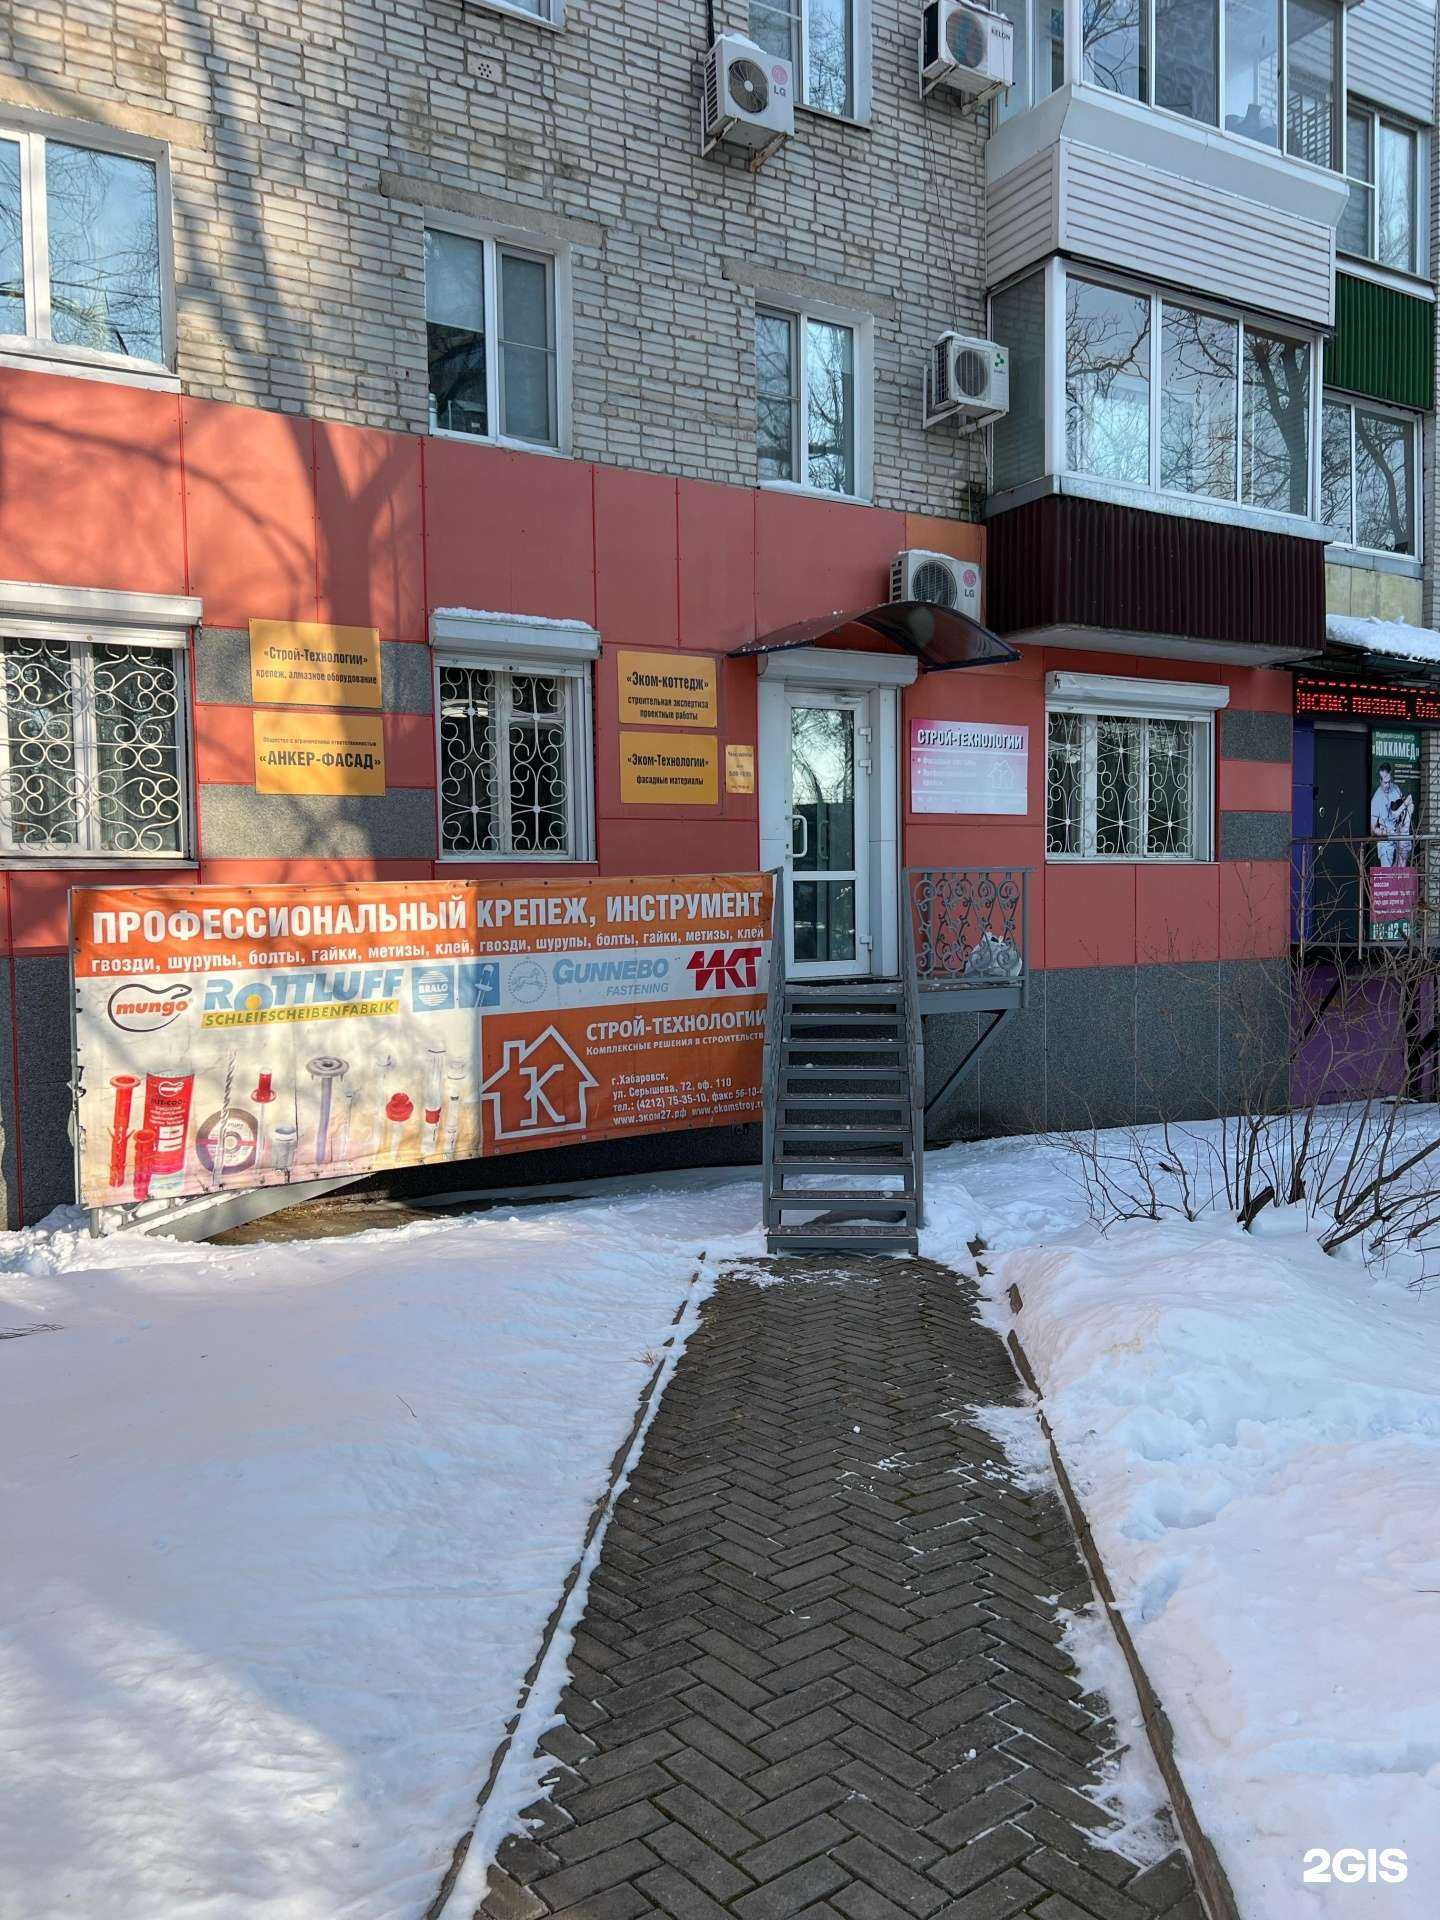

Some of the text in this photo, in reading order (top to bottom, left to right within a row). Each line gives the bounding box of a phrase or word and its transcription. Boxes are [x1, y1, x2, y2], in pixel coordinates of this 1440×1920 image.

[773, 86, 787, 97] LG
[963, 588, 975, 598] LG
[264, 646, 368, 666] «Строй-Технологии»
[327, 673, 377, 685] оборудование
[626, 671, 709, 691] «Эком-коттедж»
[627, 696, 709, 710] строительная экспертиза
[640, 709, 698, 721] проектные работы
[917, 729, 1024, 750] СТРОЙ-ТЕХНОЛОГИИ
[259, 749, 381, 770] «АНКЕР-ФАСАД»
[627, 752, 709, 768] «Эком-Технологии»
[636, 775, 704, 786] фасадные материалы
[92, 892, 763, 944] ПРОФЕССИОНАЛЬНЫЙ КРЕПЕЖ, ИНСТРУМЕНТ
[91, 926, 765, 974] гвозди, шурупы, болты, гайки, метизы, клей, гвозди, шурупы, болты, гайки, метизы, клей
[204, 967, 405, 1012] ROTTLUFF
[418, 982, 449, 994] BRALO
[606, 983, 670, 997] FASTENING
[115, 1000, 190, 1017] mungo
[205, 1001, 396, 1027] SCHLEIFSCHEIBENFABRIK
[586, 1009, 768, 1042] СТРОЙ-ТЕХНОЛОГИИ
[653, 1038, 693, 1049] РЕШЕНИЯ
[702, 1031, 770, 1045] СТРОИТЕЛЬСТВ
[715, 1077, 732, 1088] 110
[636, 1096, 666, 1111] (4212)
[711, 1089, 734, 1103] факс
